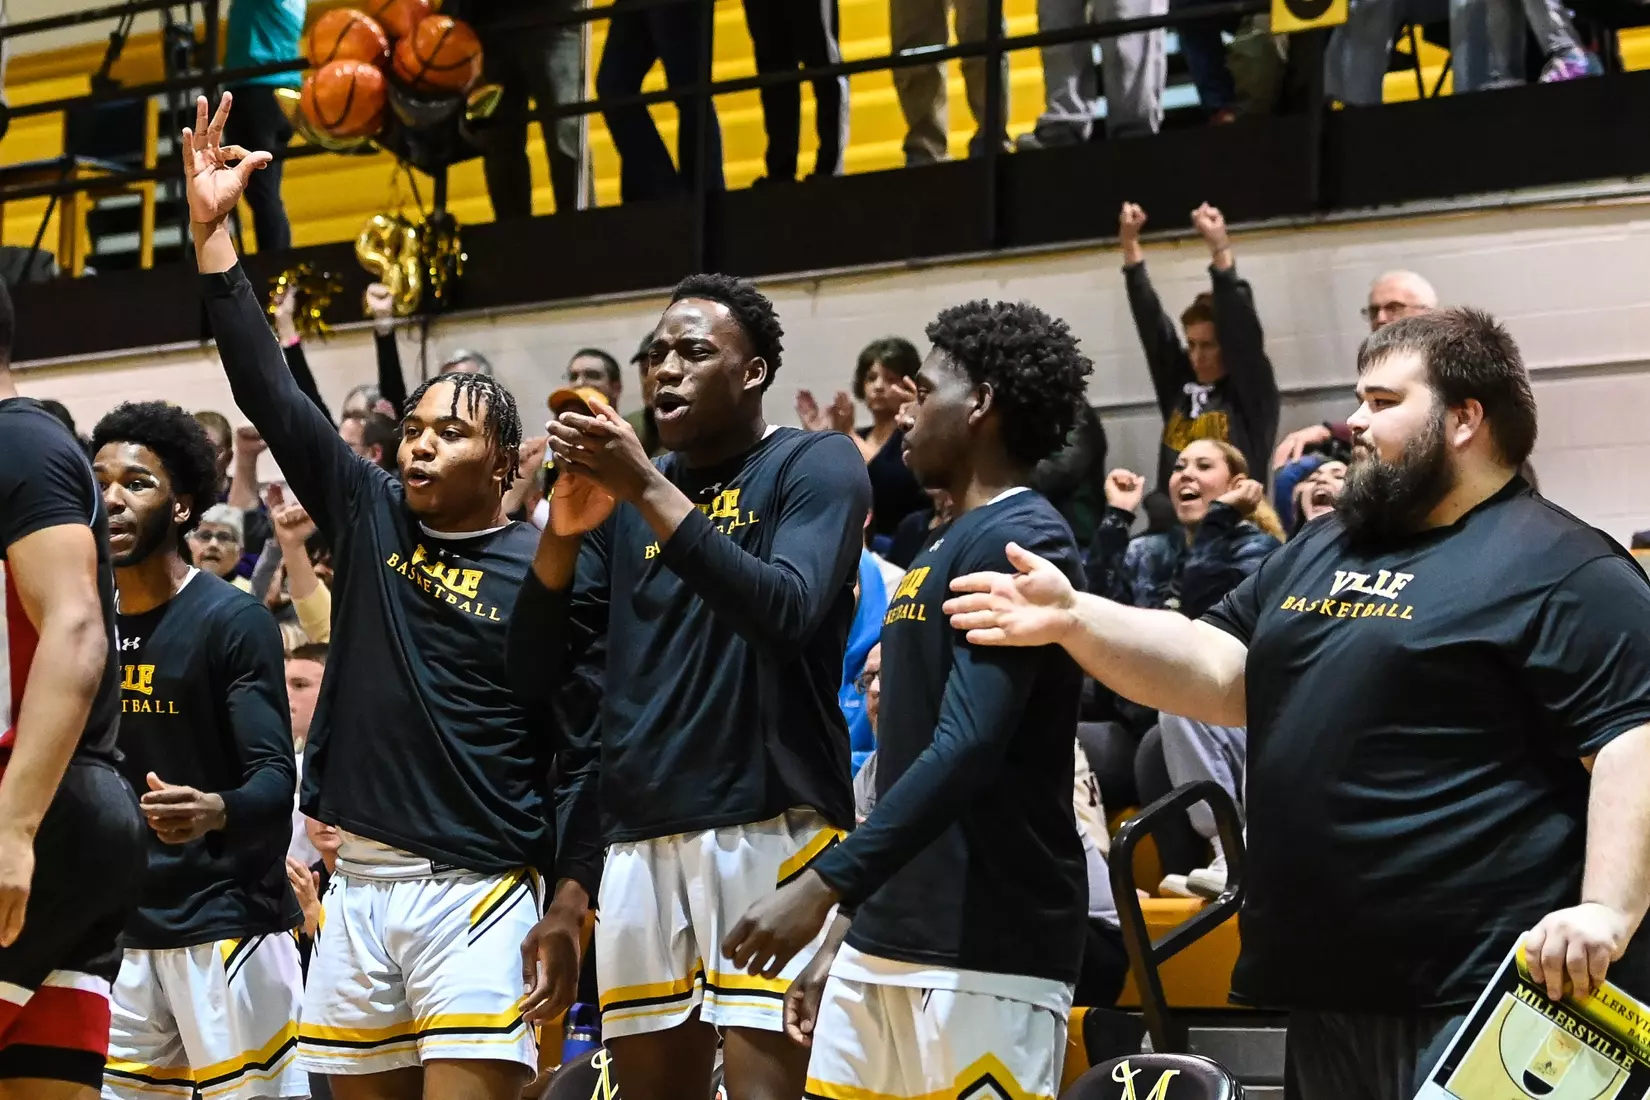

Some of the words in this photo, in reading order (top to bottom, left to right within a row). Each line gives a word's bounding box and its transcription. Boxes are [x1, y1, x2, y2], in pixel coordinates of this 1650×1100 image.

[386, 552, 501, 622] BASKETBALL
[1280, 595, 1414, 621] BASKETBALL
[121, 699, 180, 714] TBALL
[1512, 983, 1635, 1070] MILLERSVILLE
